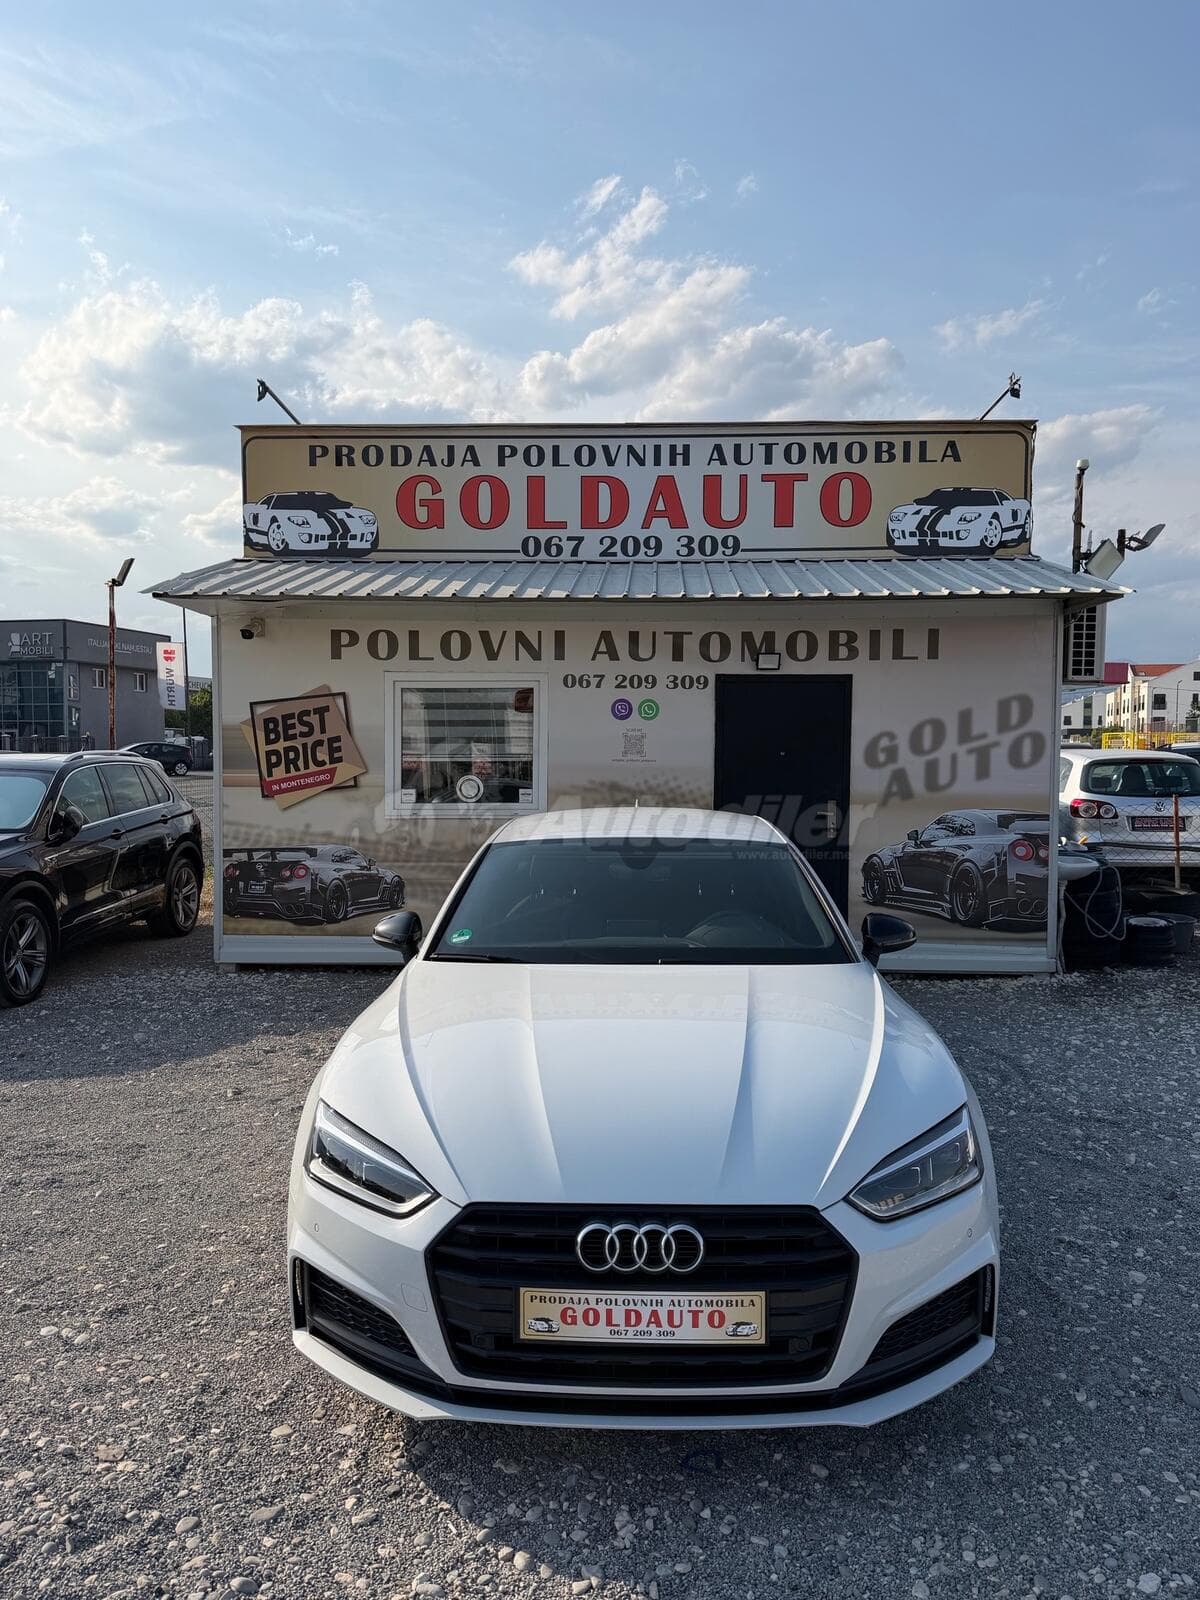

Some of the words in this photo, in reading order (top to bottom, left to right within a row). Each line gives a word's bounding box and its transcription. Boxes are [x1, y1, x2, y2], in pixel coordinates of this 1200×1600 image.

[308, 443, 482, 467] PRODAJA
[497, 443, 691, 467] POLOVNIH
[707, 440, 962, 466] AUTOMOBILA
[395, 473, 873, 530] GOLDAUTO
[520, 535, 585, 558] 067
[598, 535, 663, 558] 209
[675, 534, 741, 558] 309
[20, 646, 53, 655] MOBILI
[21, 632, 52, 645] ART
[329, 629, 566, 661] POLOVNI
[590, 628, 940, 663] AUTOMOBILI
[562, 673, 606, 689] 067
[614, 674, 657, 689] 209
[665, 674, 709, 690] 309
[262, 705, 330, 746] BEST
[863, 693, 1034, 770] GOLD
[265, 735, 343, 778] PRICE
[881, 730, 1047, 807] AUTO
[271, 783, 280, 791] IN
[281, 773, 331, 789] MONTENEGRO
[530, 1295, 590, 1305] PRODAJA
[595, 1297, 664, 1307] POLOVNIH
[668, 1299, 756, 1308] AUTOMOBILA
[559, 1307, 726, 1328] GOLDAUTO
[609, 1329, 629, 1337] 067
[632, 1329, 652, 1338] 209
[655, 1329, 676, 1338] 309
